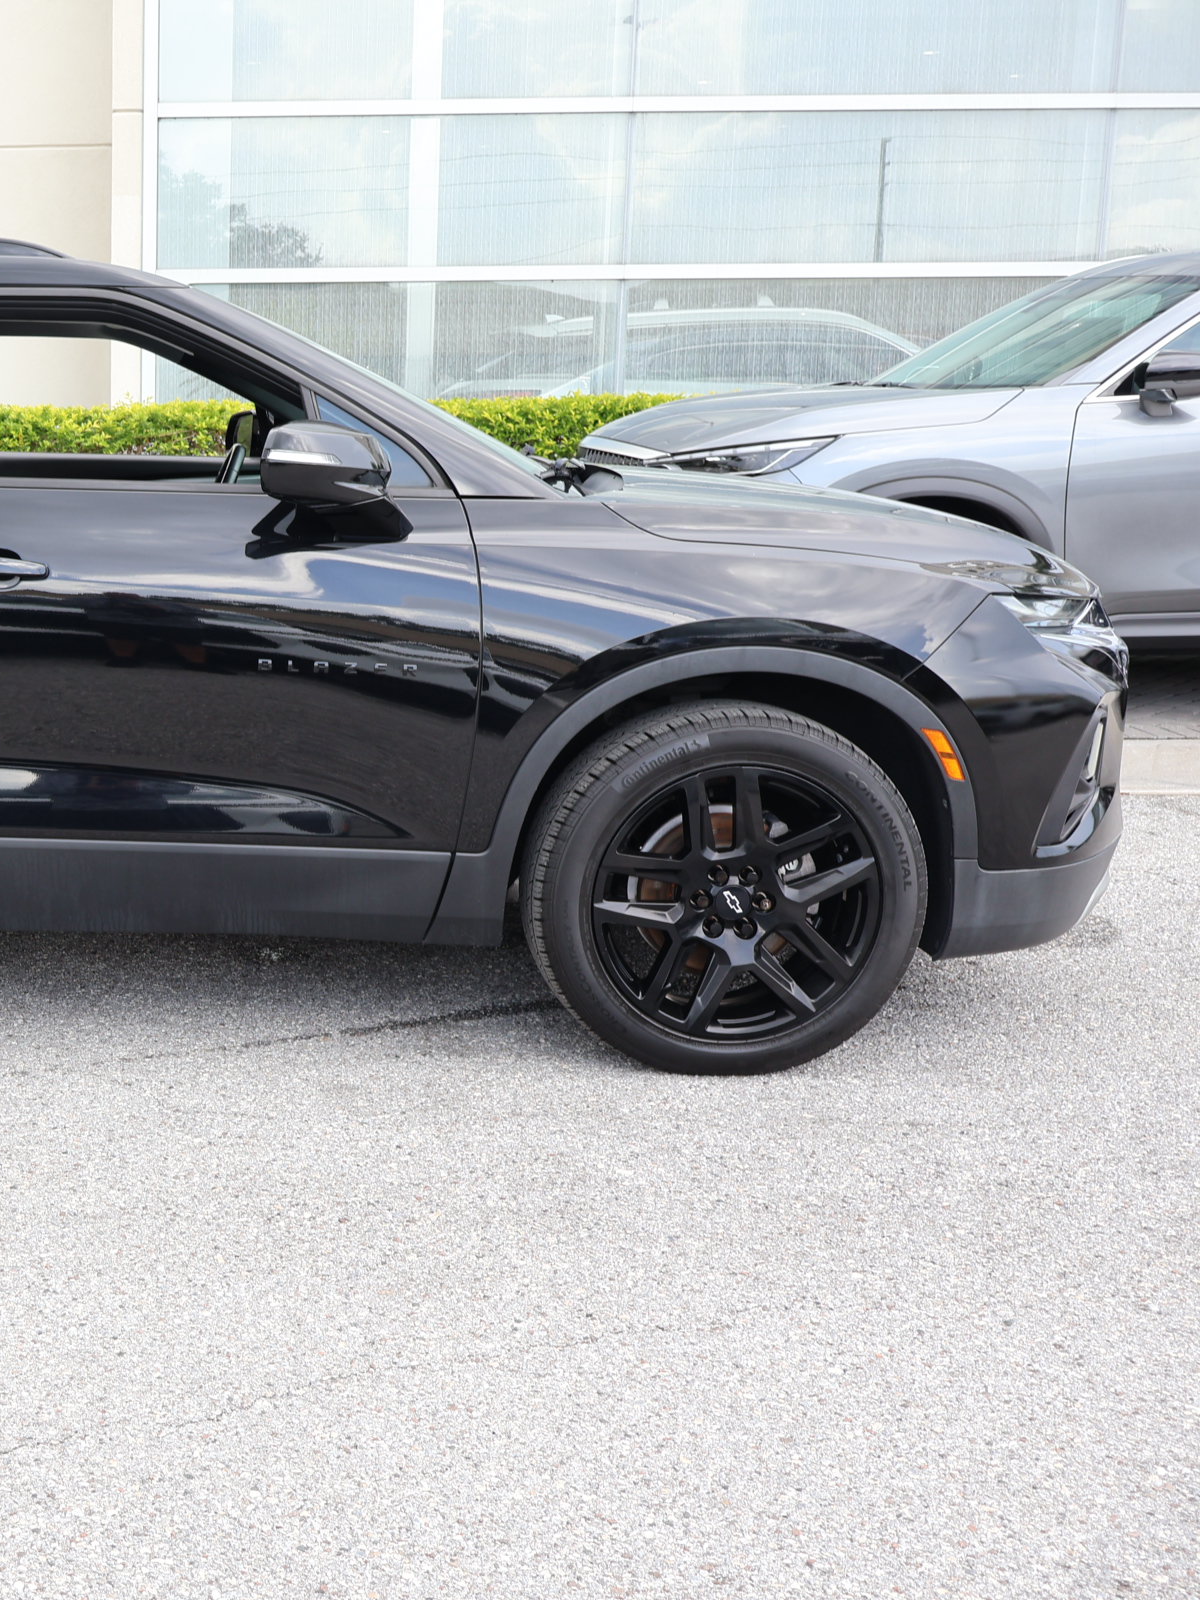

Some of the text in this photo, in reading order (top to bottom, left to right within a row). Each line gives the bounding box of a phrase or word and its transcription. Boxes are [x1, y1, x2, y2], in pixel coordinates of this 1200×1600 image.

[258, 659, 417, 677] BLAZER
[621, 742, 691, 789] Continental
[846, 770, 912, 892] CONTINENTAL
